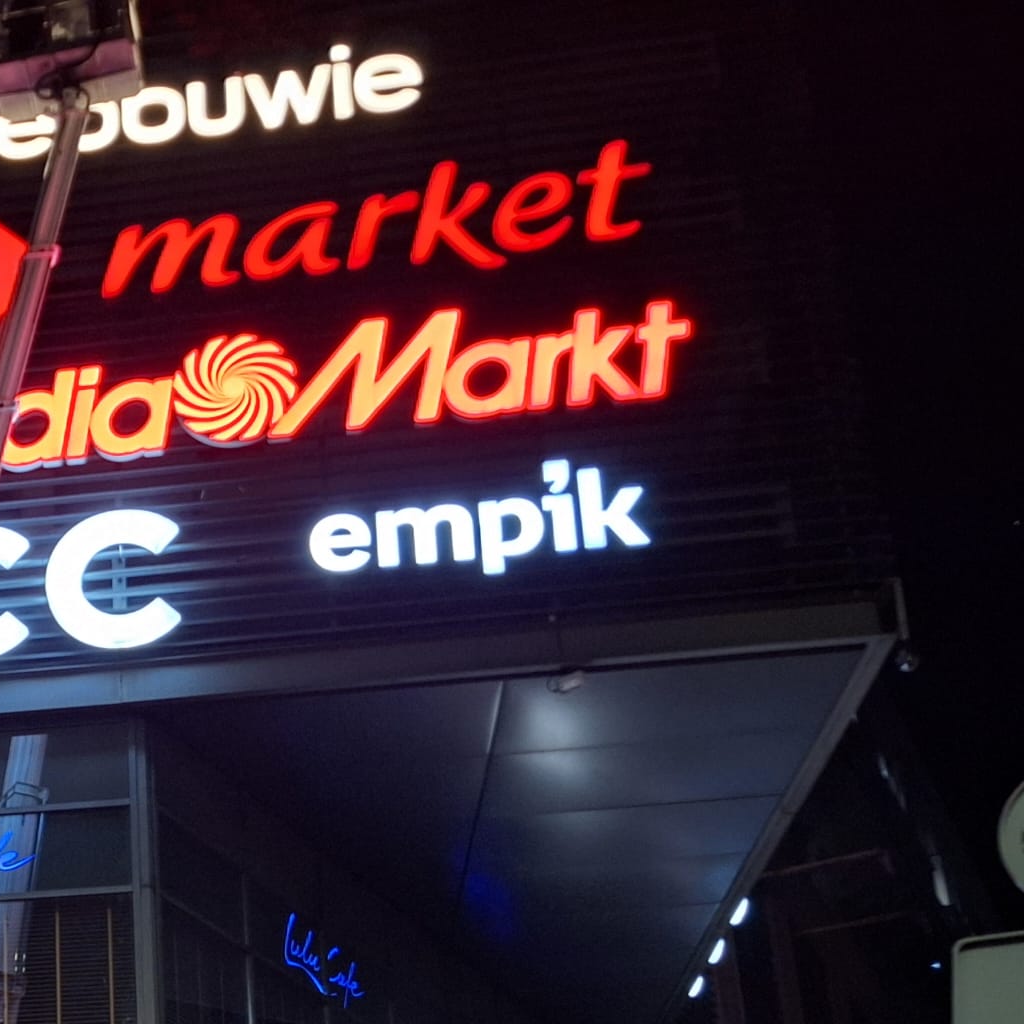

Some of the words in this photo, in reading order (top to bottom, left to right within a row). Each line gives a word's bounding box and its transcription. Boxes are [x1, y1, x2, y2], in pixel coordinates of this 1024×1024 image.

[101, 138, 653, 299] market
[269, 300, 692, 440] Markt
[309, 458, 651, 575] empik
